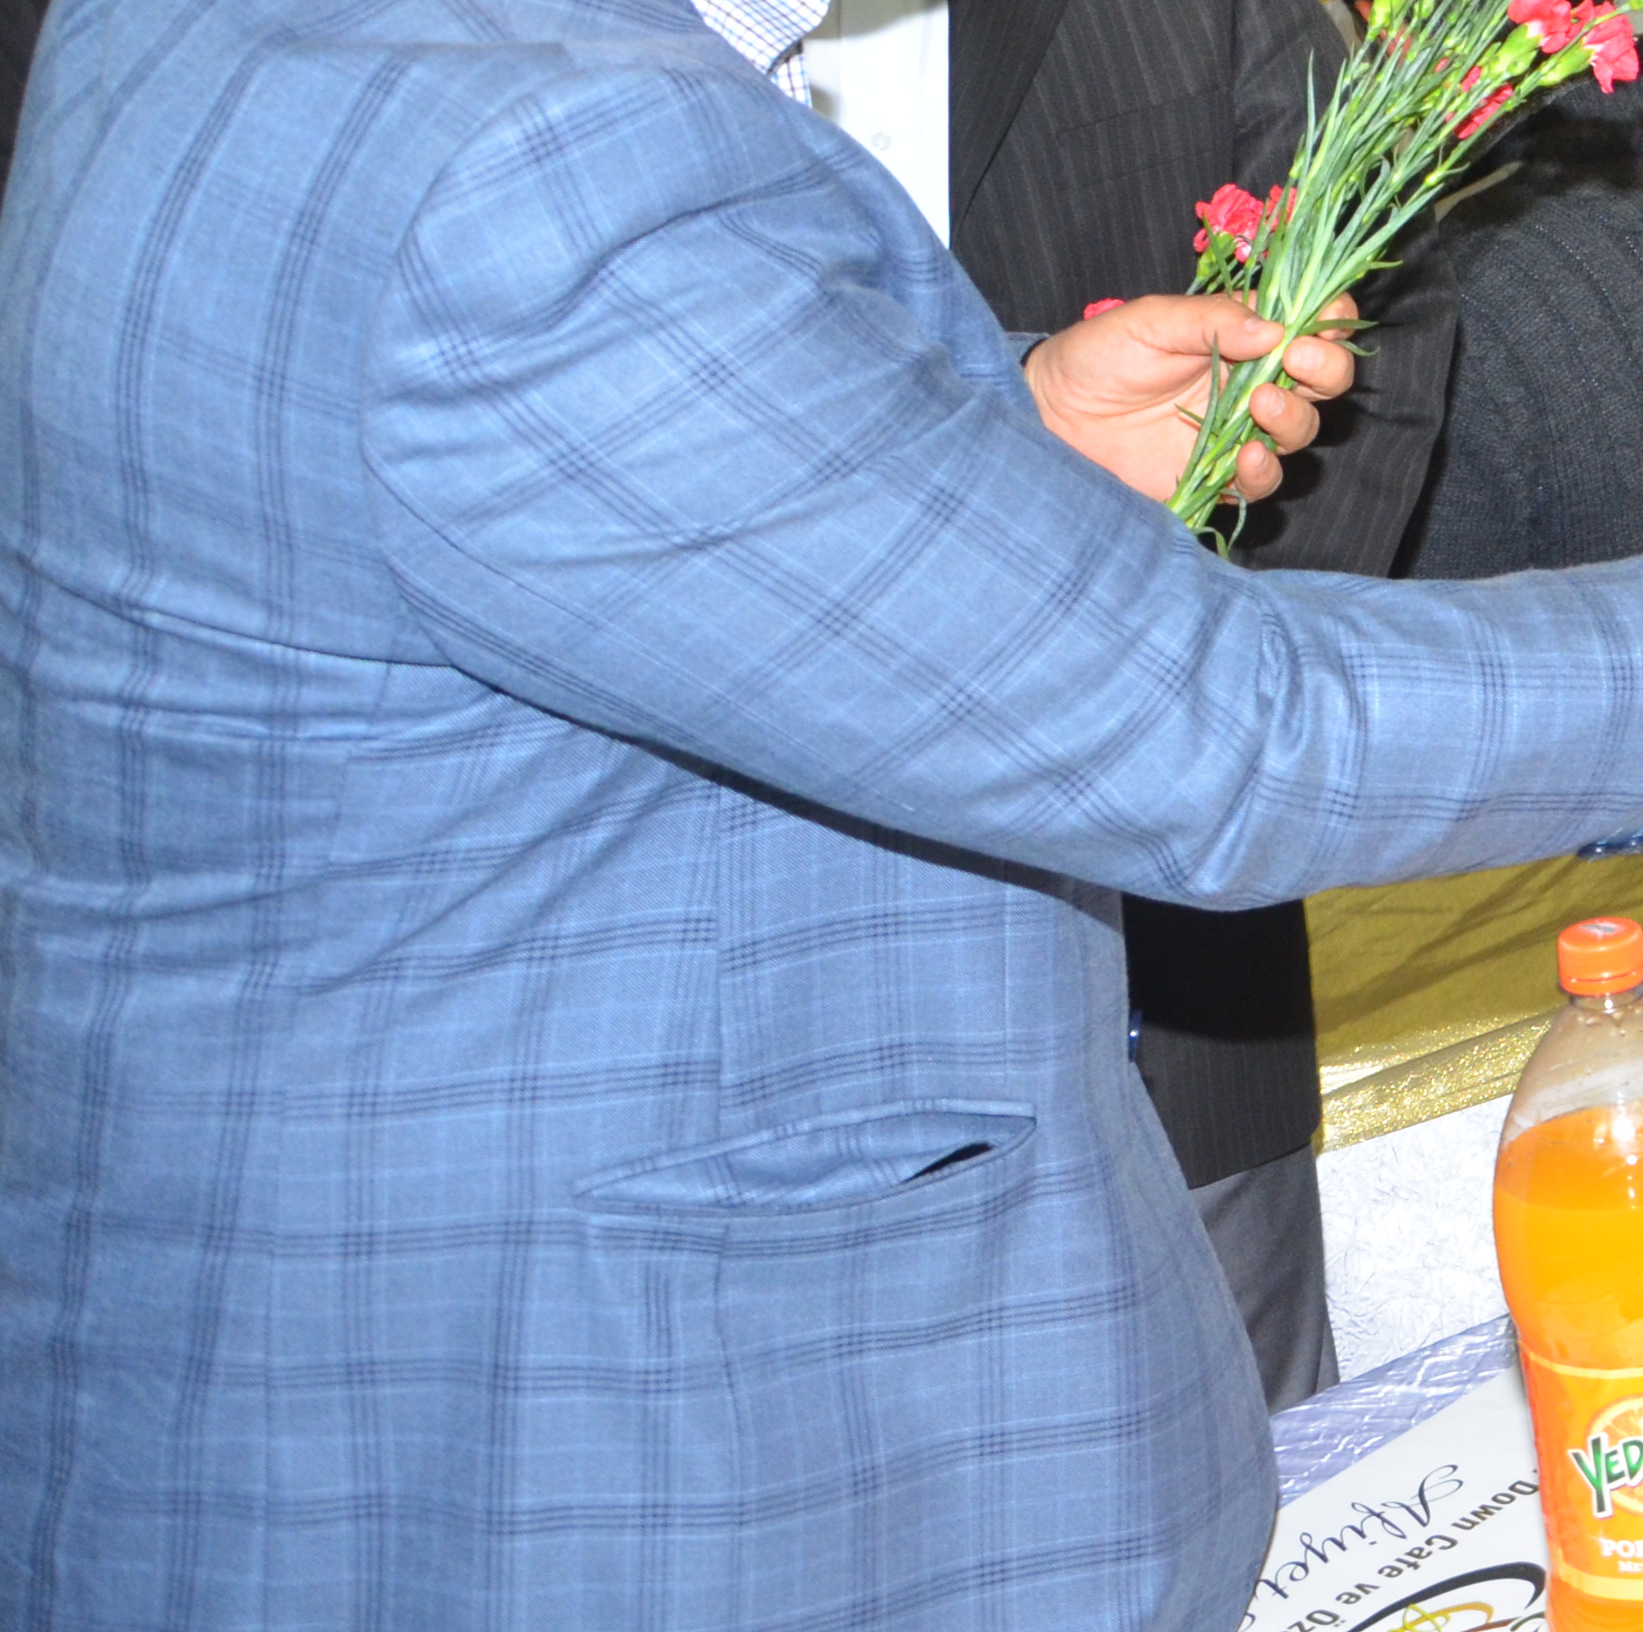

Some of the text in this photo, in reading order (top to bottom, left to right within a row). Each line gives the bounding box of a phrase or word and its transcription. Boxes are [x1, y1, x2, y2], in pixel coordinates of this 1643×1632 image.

[1451, 1478, 1539, 1531] Down
[1254, 1464, 1463, 1599] Afiyet
[1378, 1534, 1458, 1578] Cafe
[1335, 1582, 1380, 1604] ve
